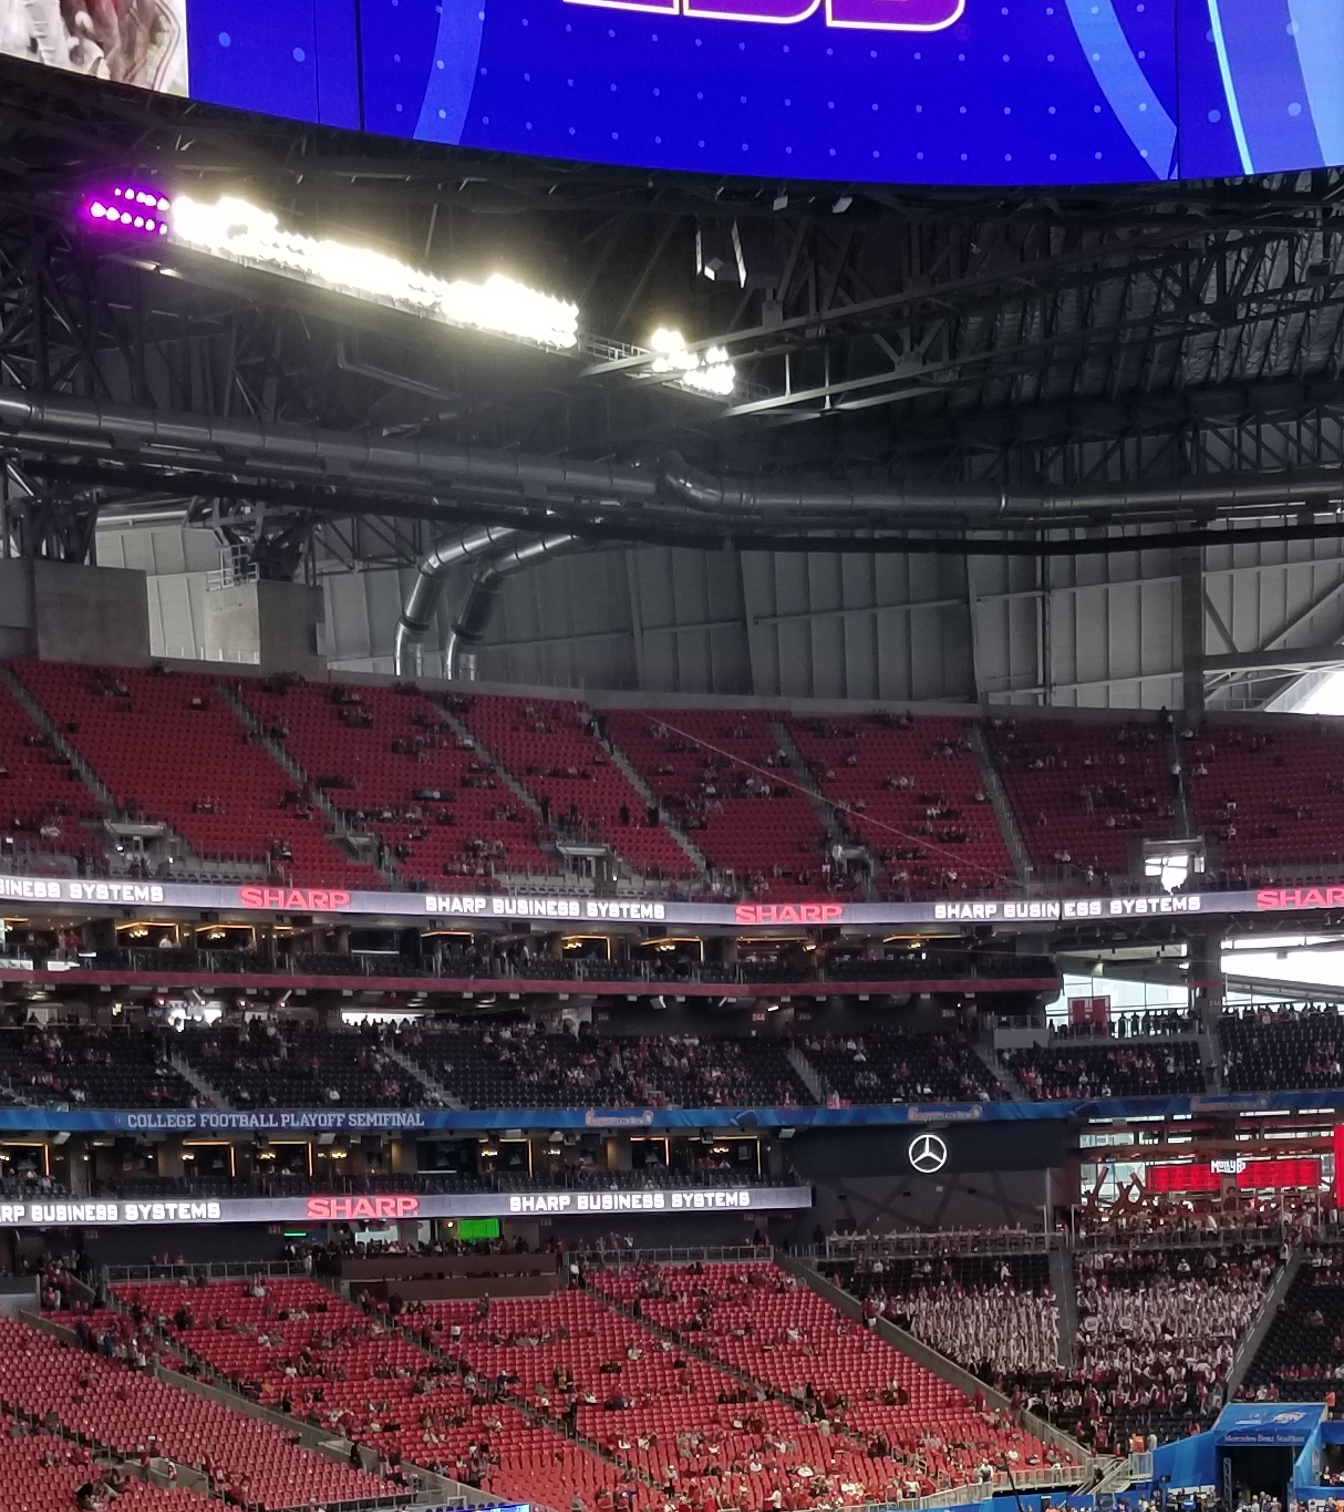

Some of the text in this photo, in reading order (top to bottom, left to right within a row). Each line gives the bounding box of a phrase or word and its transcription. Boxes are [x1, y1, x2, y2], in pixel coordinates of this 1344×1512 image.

[69, 882, 164, 902] SYSTEMS
[240, 886, 351, 910] SHARP
[425, 895, 665, 920] SHARP BUSINESS SYSTEMS
[735, 903, 843, 924] SHARP
[935, 896, 1201, 919] SHARP BUSINESS SYSTEMS
[127, 1113, 425, 1129] COLLEGE FOOTBALL PLAYOFF SEMIFINAL
[31, 1204, 118, 1222] BUSINESS
[124, 1202, 221, 1221] SYSTEMS
[308, 1195, 419, 1218] SHARP
[509, 1191, 750, 1212] SHARP BUSINESS SYSTEMS
[1223, 1433, 1305, 1443] Mercedes-Benz Stadium
